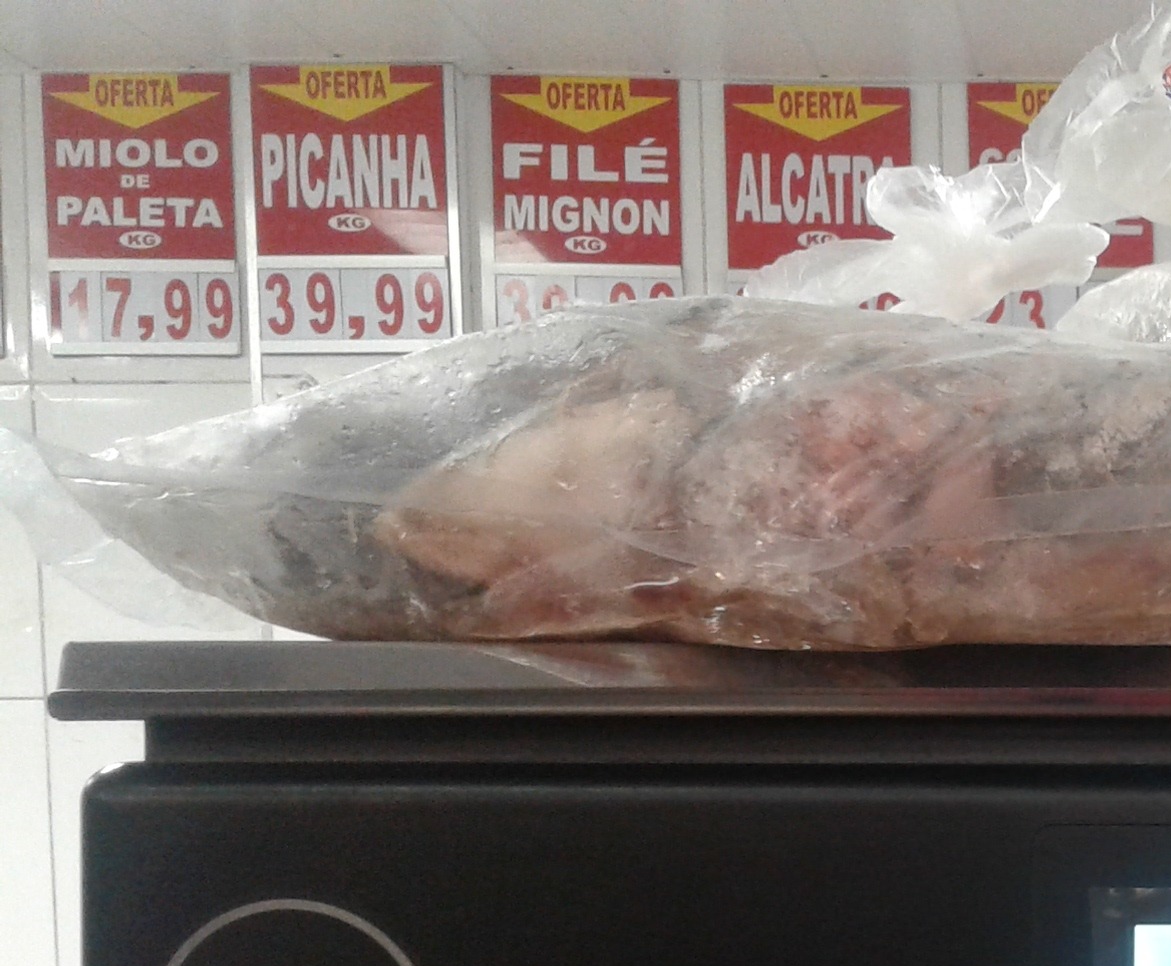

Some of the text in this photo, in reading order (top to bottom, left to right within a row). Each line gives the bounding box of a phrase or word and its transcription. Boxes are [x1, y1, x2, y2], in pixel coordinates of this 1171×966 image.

[94, 80, 174, 108] OFERTA
[306, 70, 386, 99] OFERTA
[546, 82, 625, 111] OFERTA
[779, 91, 857, 119] OFERTA
[55, 139, 219, 169] MIOLO
[503, 138, 669, 183] FILÉ
[121, 174, 150, 189] DE
[261, 133, 438, 209] PICANHA
[735, 153, 893, 226] ALCATR
[56, 197, 223, 228] PALETA
[336, 215, 366, 229] KG
[504, 194, 669, 236] MIGNON
[127, 233, 158, 247] KG
[572, 238, 600, 252] KG
[67, 277, 233, 341] 17,99
[265, 272, 443, 339] 39,99
